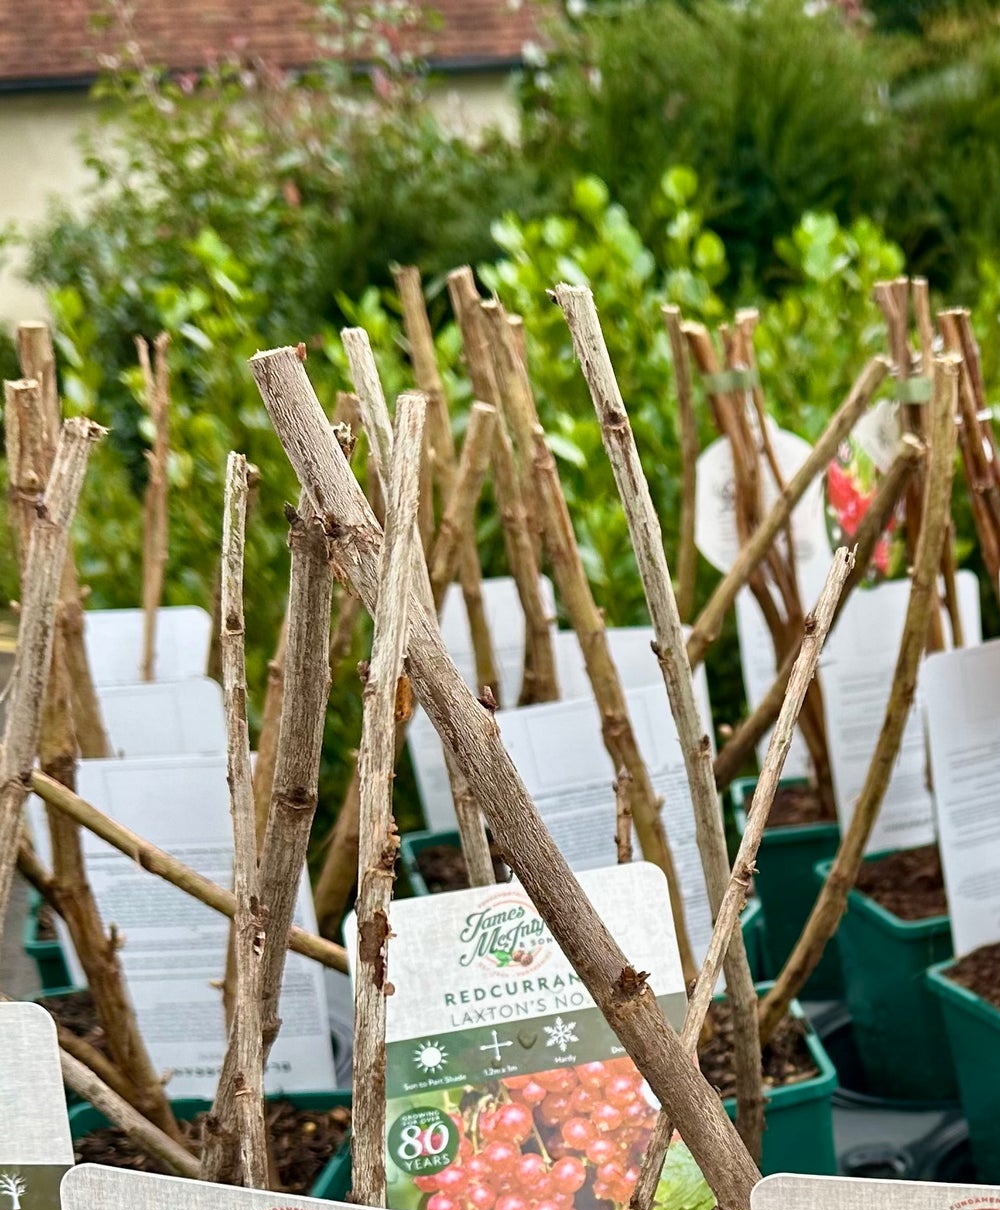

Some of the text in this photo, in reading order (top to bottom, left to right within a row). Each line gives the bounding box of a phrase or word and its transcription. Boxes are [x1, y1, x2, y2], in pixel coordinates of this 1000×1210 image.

[460, 906, 525, 942] James
[532, 937, 553, 946] SON
[459, 918, 544, 967] McInty
[444, 973, 582, 1006] REDCURRAN
[451, 992, 590, 1028] LAXTON'S NO.
[398, 1120, 449, 1159] 80
[405, 1154, 450, 1171] YEARS
